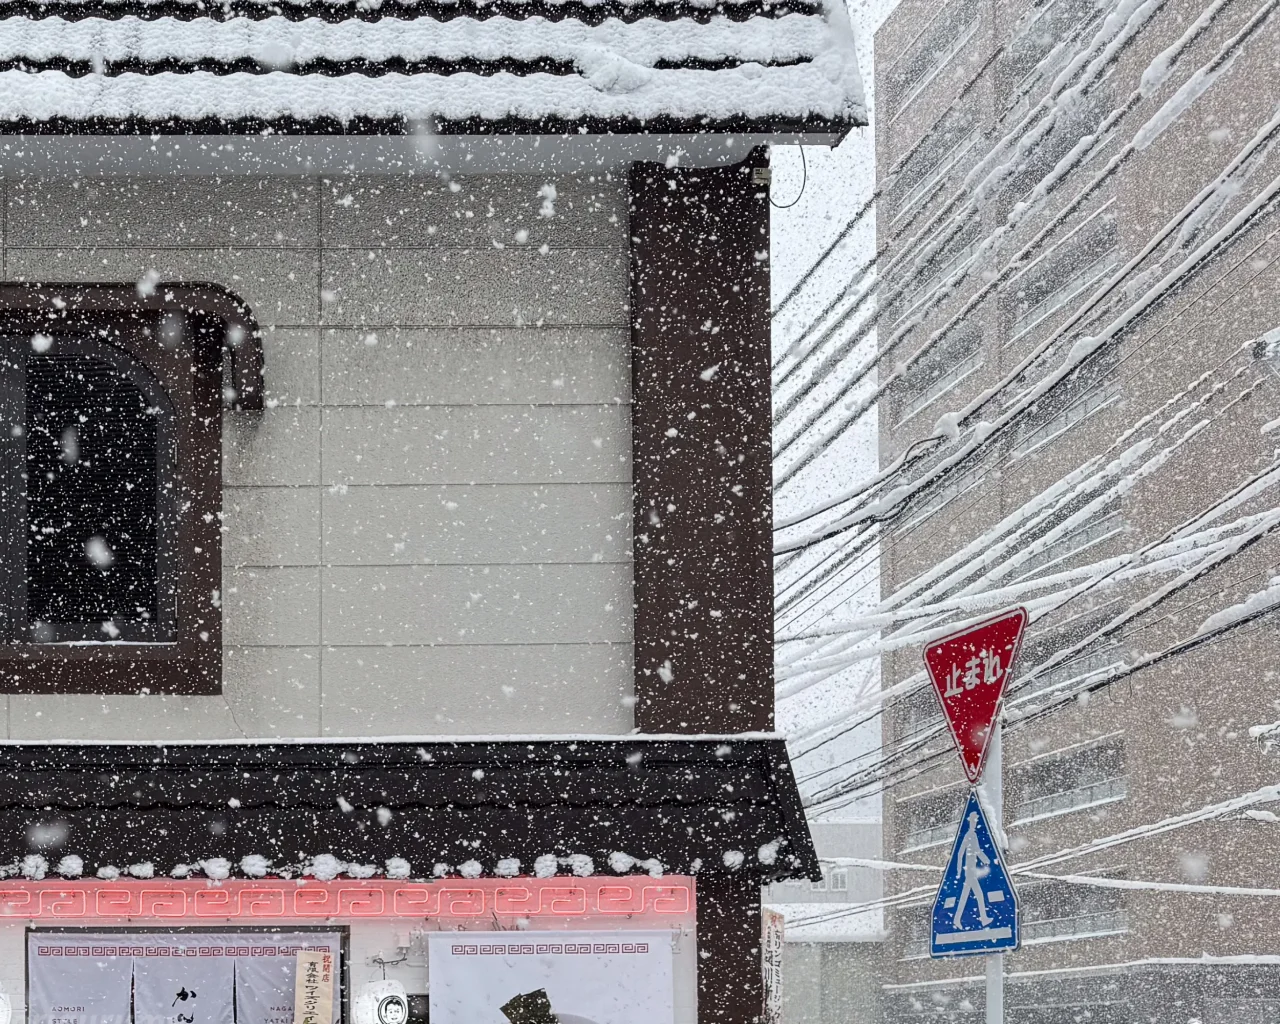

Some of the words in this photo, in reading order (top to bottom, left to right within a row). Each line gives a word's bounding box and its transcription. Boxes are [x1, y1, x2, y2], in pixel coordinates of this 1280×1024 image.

[943, 648, 1003, 698] 止まれ
[322, 954, 332, 983] 祝開店
